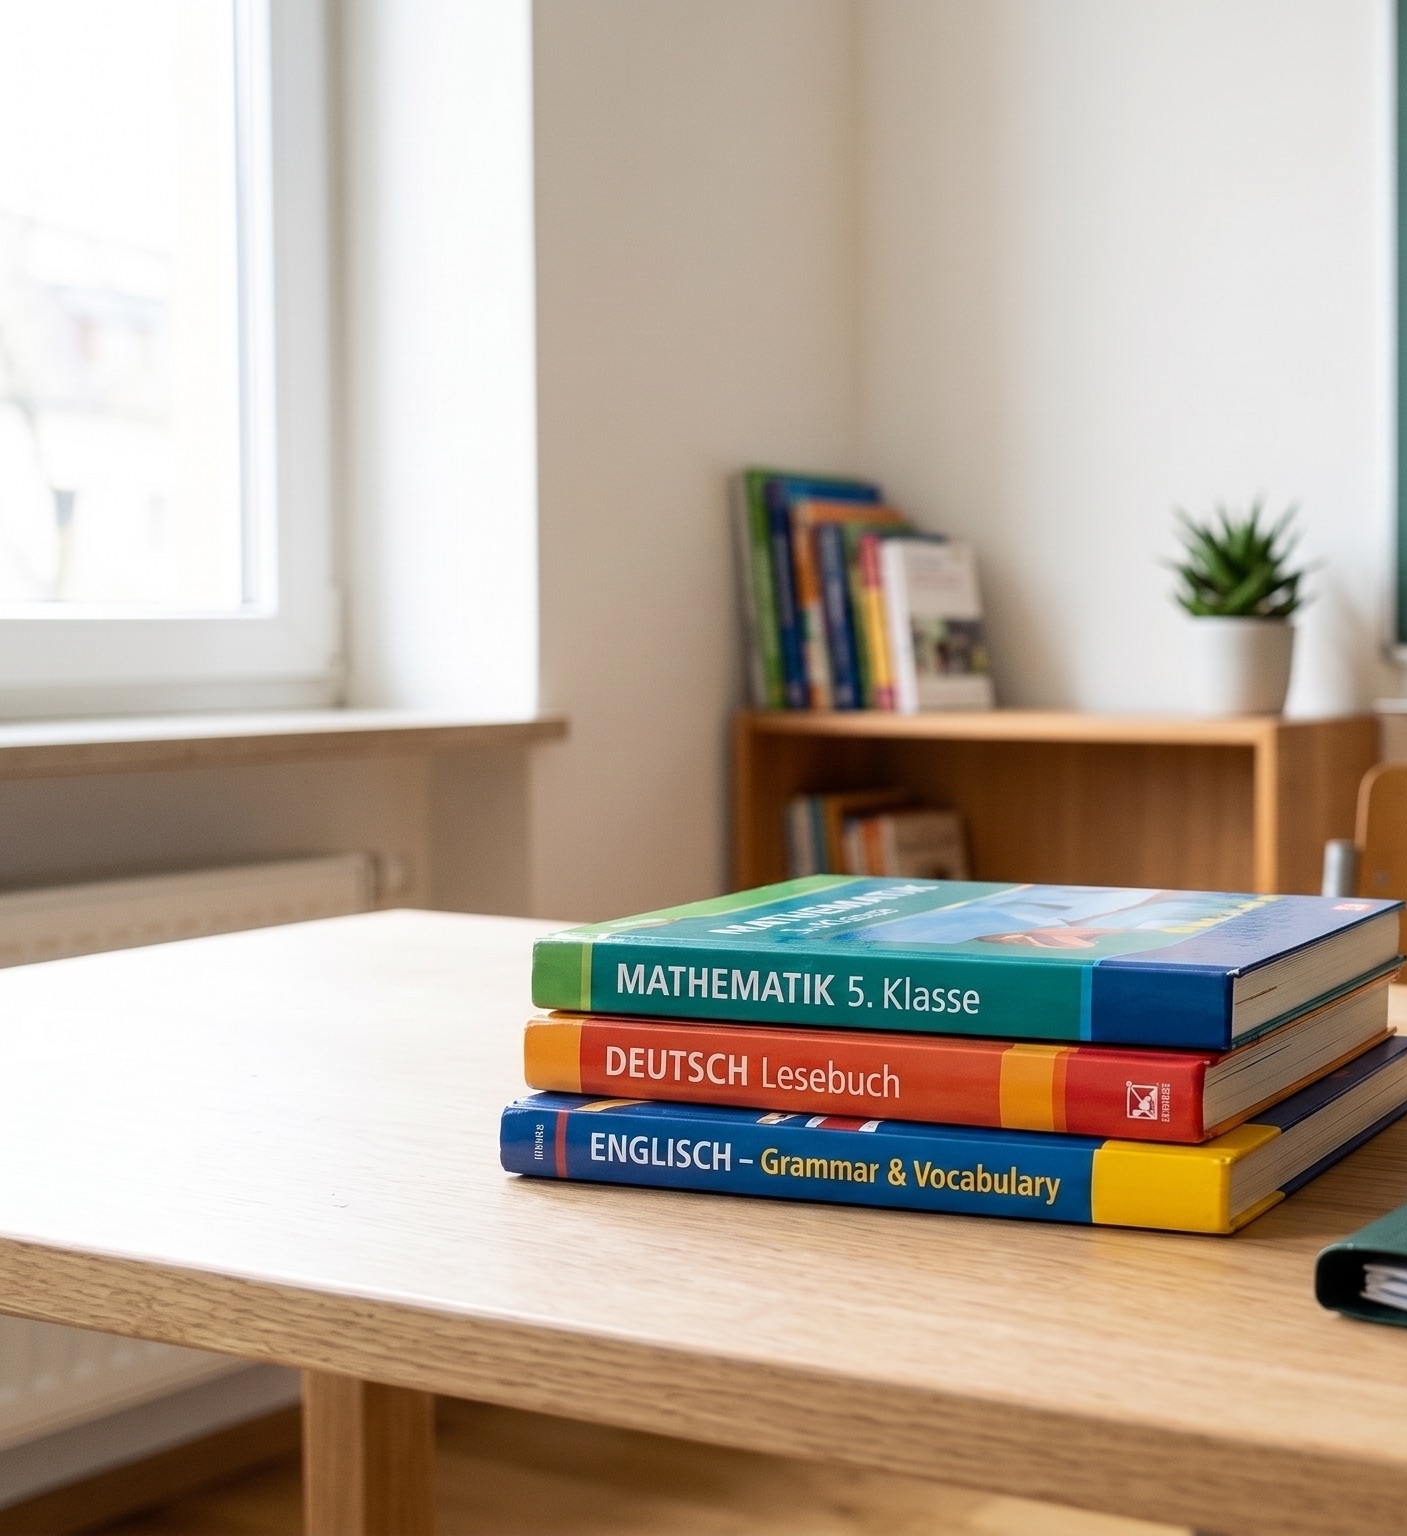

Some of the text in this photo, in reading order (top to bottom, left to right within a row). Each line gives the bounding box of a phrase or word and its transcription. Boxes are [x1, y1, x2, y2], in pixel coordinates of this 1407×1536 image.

[617, 963, 981, 1015] MATHEMATIK 5. Klasse
[606, 1045, 900, 1099] DEUTSCH Lesebuch
[590, 1132, 732, 1172] ENGLISCH
[760, 1147, 880, 1183] Grammar
[887, 1157, 908, 1187] &
[913, 1160, 1062, 1205] Vocabulary
